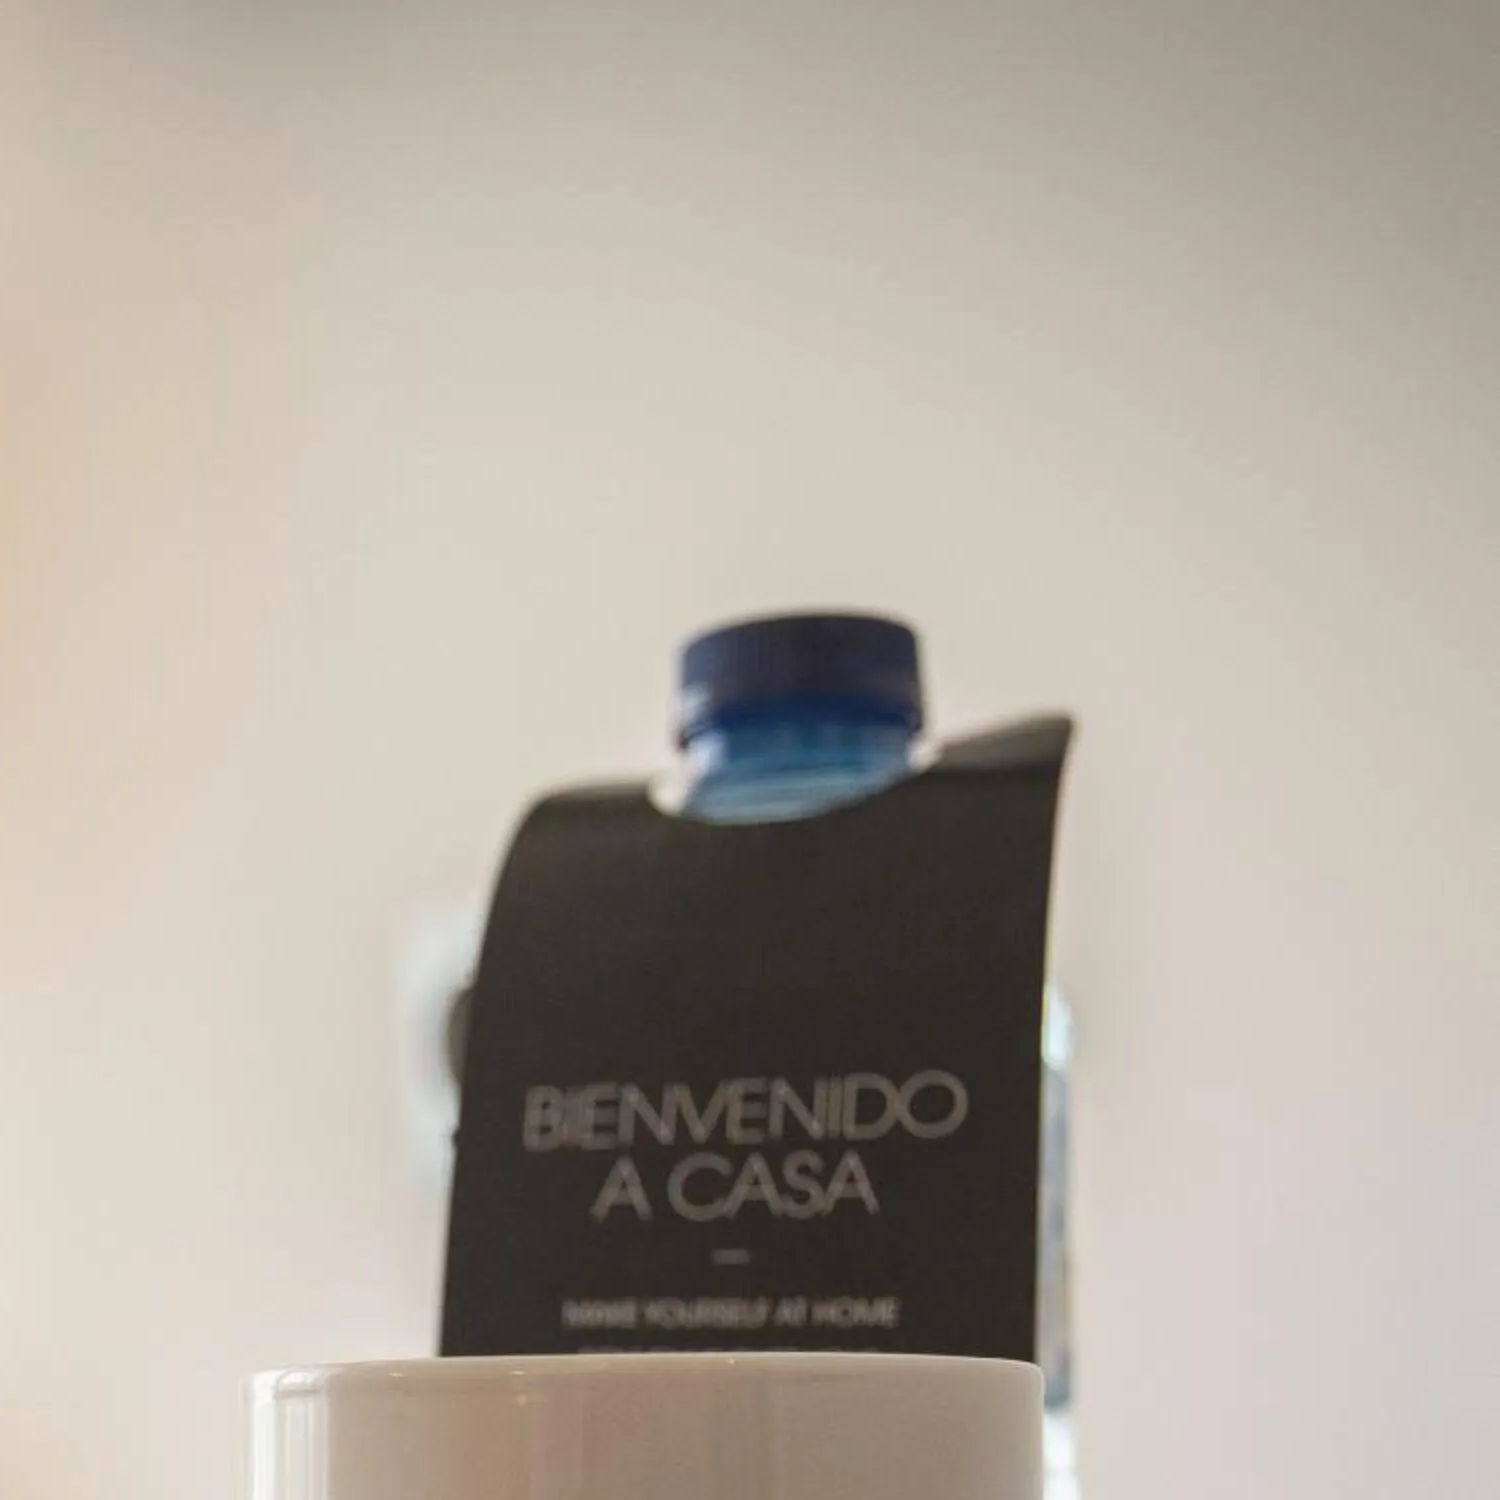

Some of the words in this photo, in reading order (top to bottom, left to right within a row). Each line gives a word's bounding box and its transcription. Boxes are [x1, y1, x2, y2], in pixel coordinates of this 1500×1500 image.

[522, 1068, 969, 1151] BIENVENIDO
[590, 1156, 652, 1221] A
[667, 1150, 880, 1221] CASA
[812, 1296, 899, 1328] HOME
